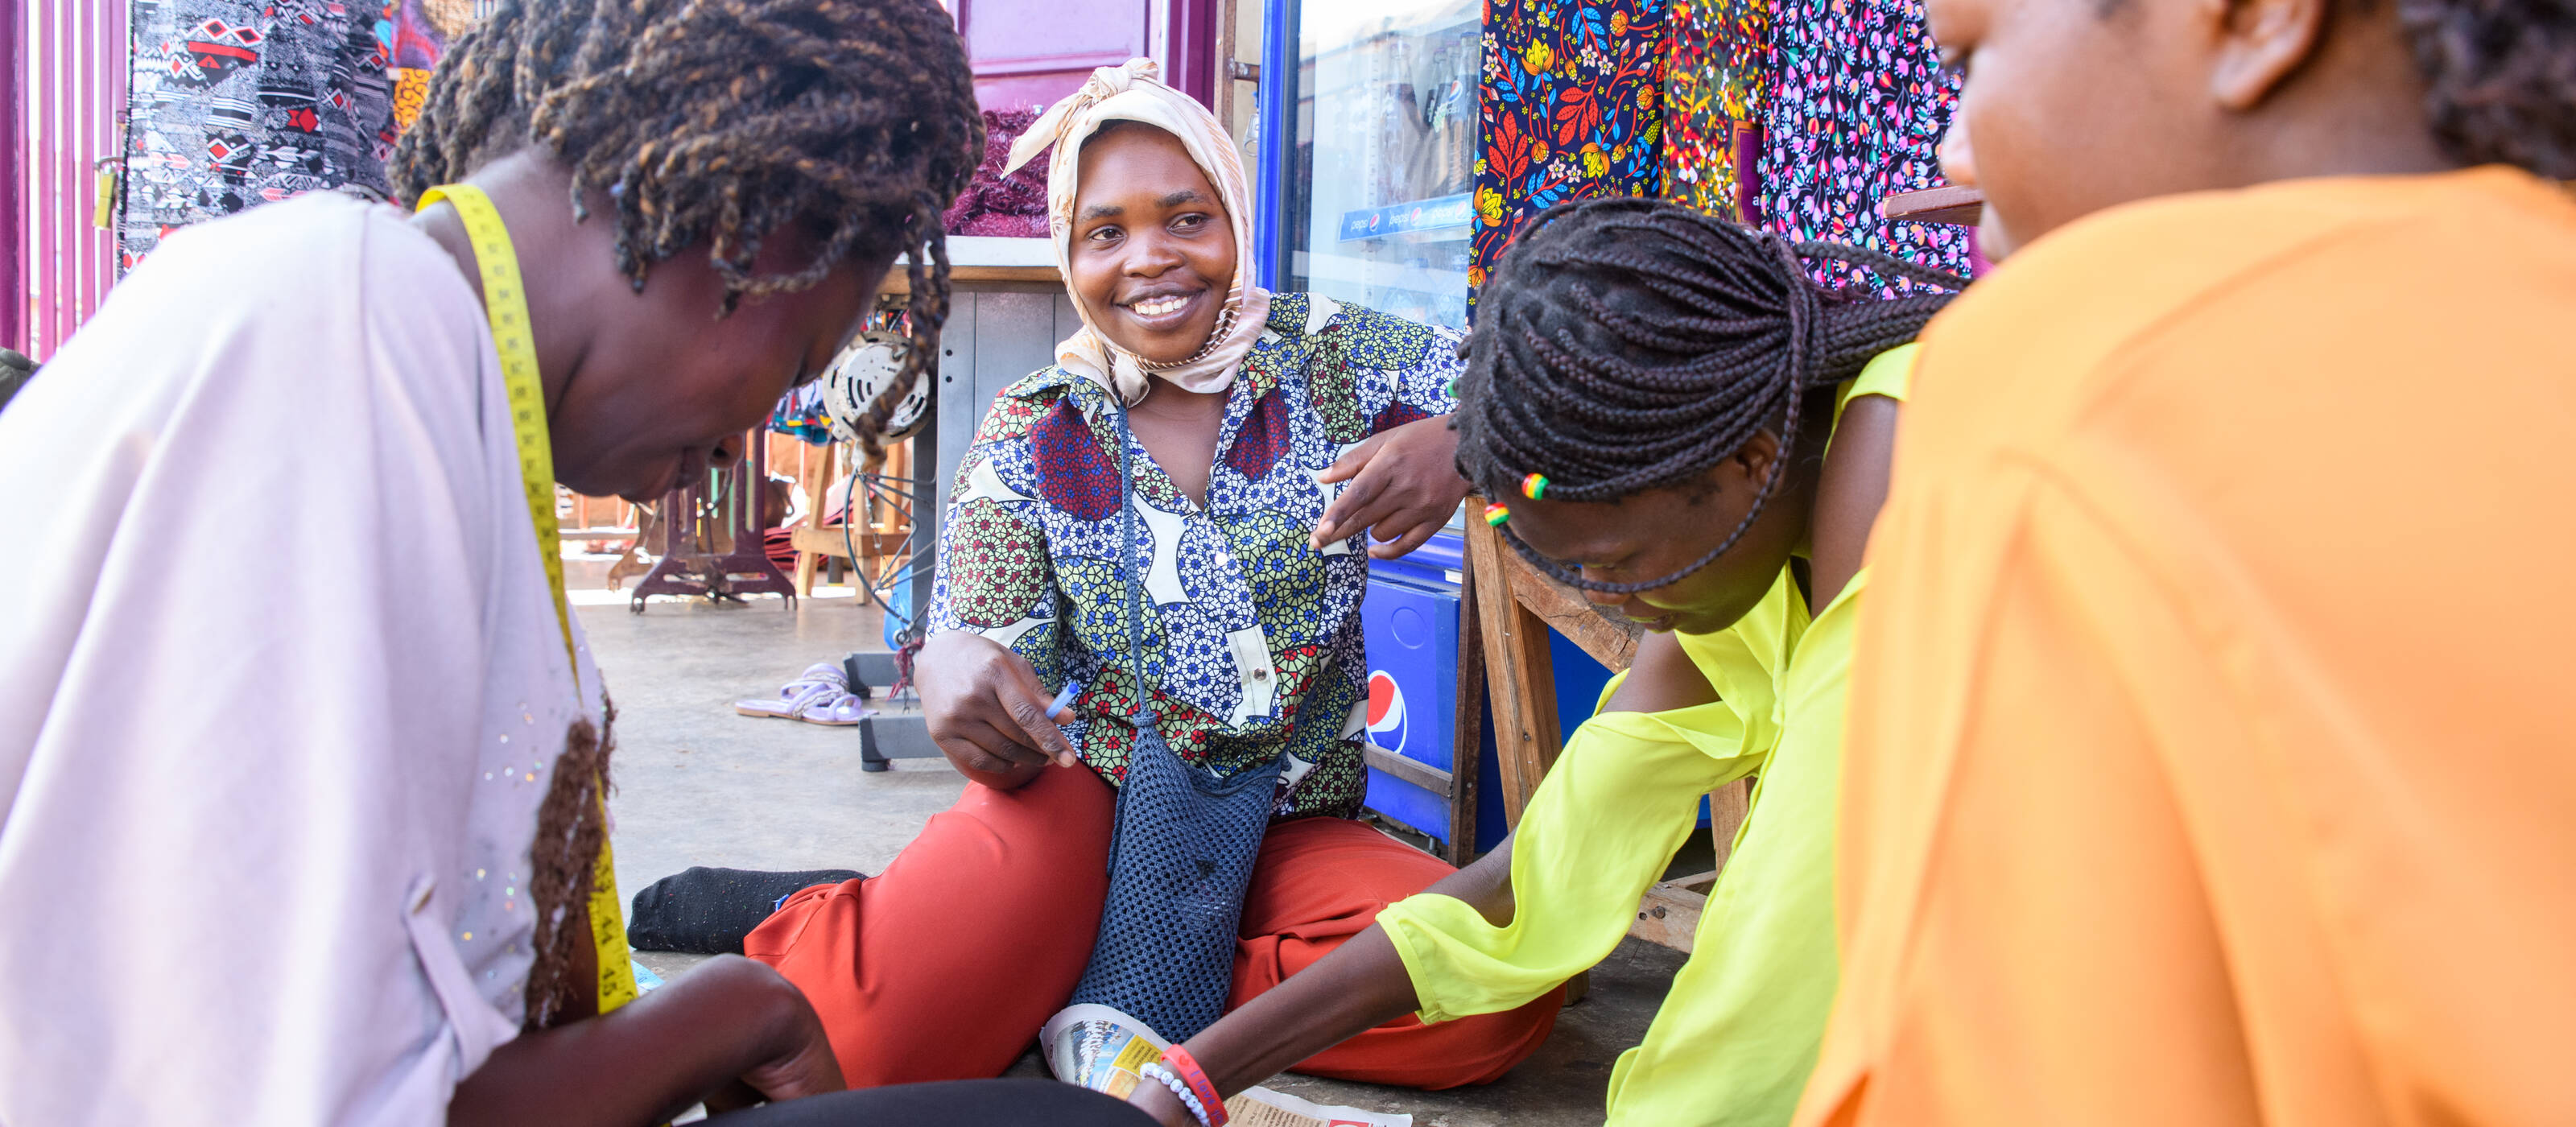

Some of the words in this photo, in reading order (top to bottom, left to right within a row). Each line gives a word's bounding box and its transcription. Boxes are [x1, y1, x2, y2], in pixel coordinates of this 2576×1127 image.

[1351, 219, 1368, 232] pepsi
[1389, 212, 1409, 226] pepsi
[602, 916, 613, 945] 44
[603, 968, 617, 997] 45
[1191, 1070, 1200, 1078] I
[1197, 1079, 1216, 1105] love
